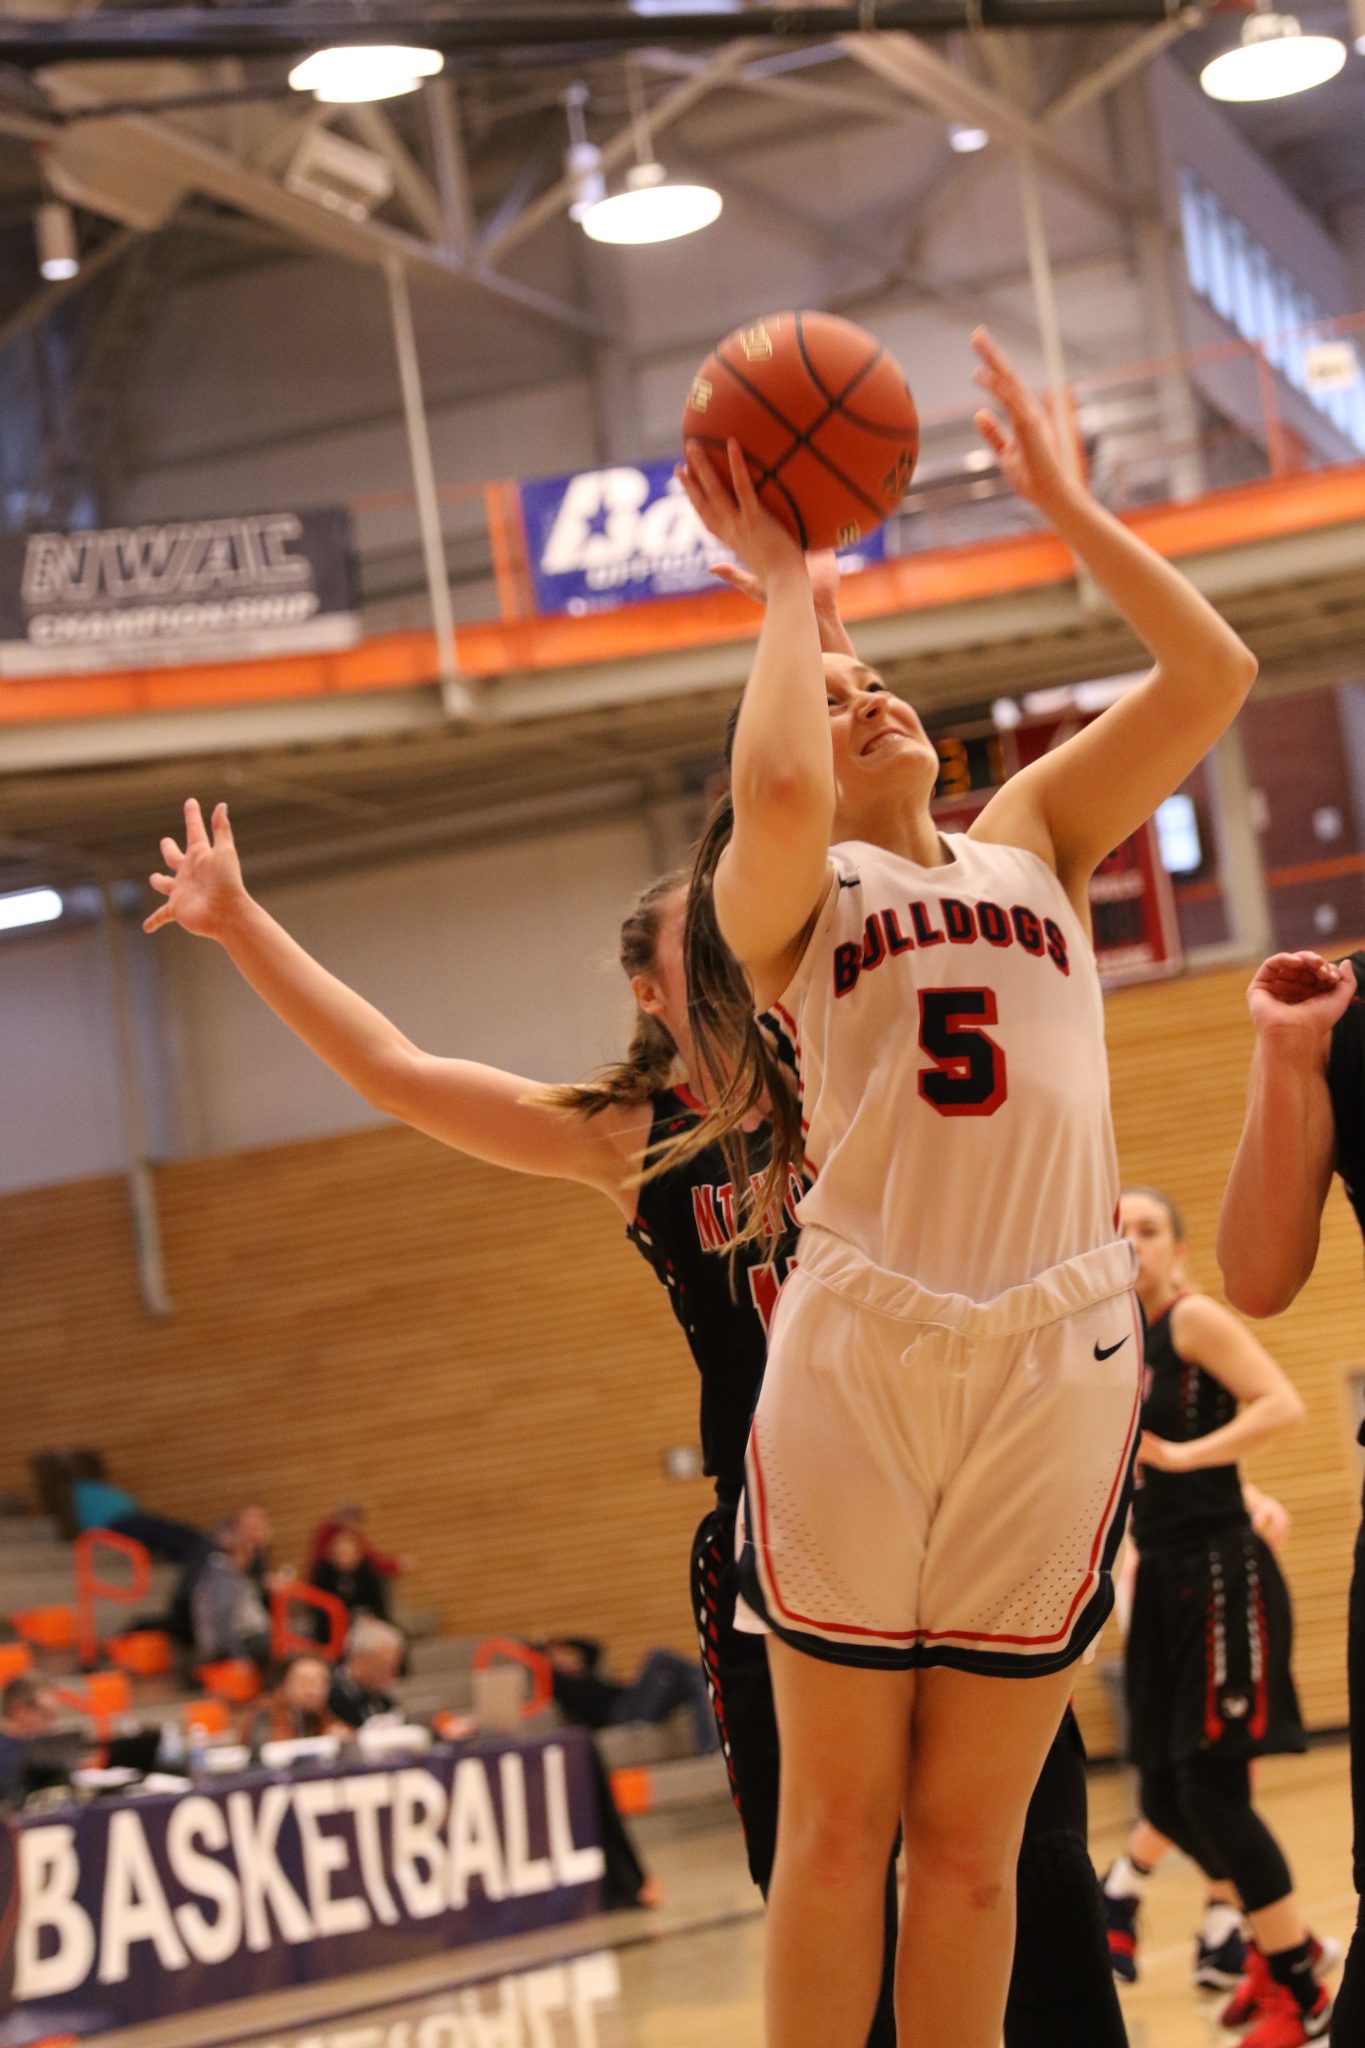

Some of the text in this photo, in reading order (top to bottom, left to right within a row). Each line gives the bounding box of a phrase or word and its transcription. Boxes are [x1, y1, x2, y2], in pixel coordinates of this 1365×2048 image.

[834, 898, 1070, 998] BULLDOGS
[917, 986, 1008, 1117] 5
[13, 1745, 605, 2000] BASKETBALL
